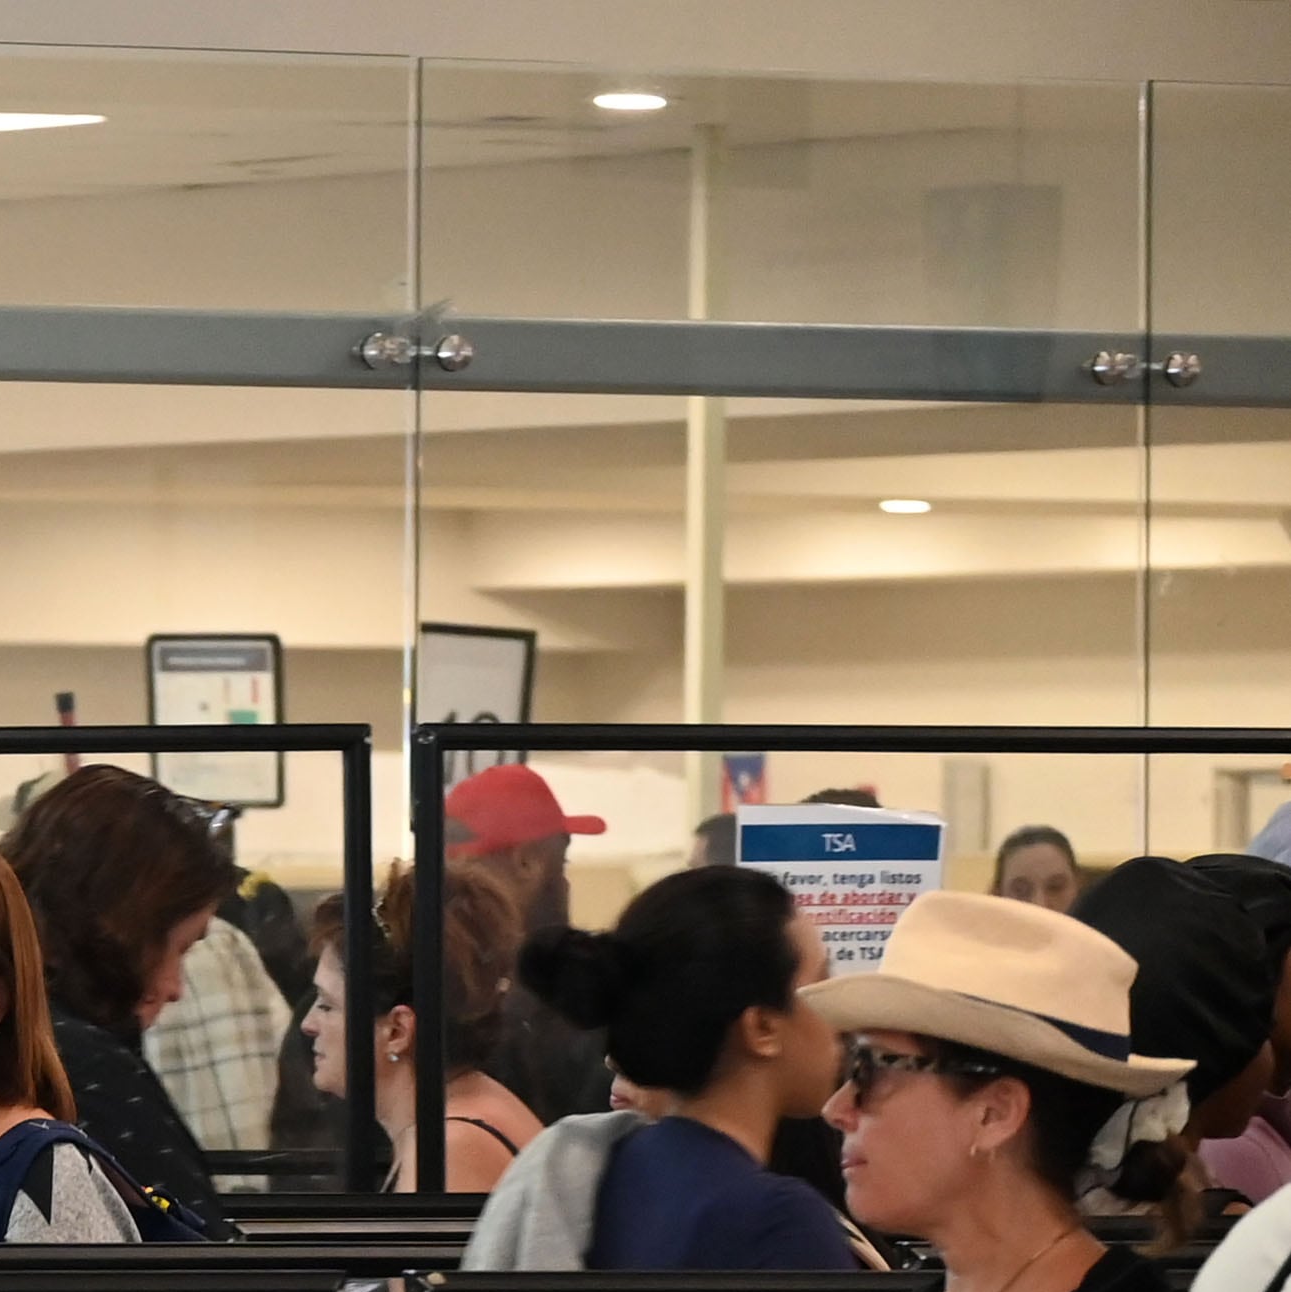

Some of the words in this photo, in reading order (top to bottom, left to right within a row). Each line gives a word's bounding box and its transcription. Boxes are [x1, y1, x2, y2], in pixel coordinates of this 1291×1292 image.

[821, 833, 857, 852] TSA
[783, 872, 827, 887] favor,
[833, 872, 875, 888] tenga
[880, 870, 922, 885] listos
[819, 890, 837, 905] de
[842, 890, 901, 905] abordar
[836, 946, 854, 961] de
